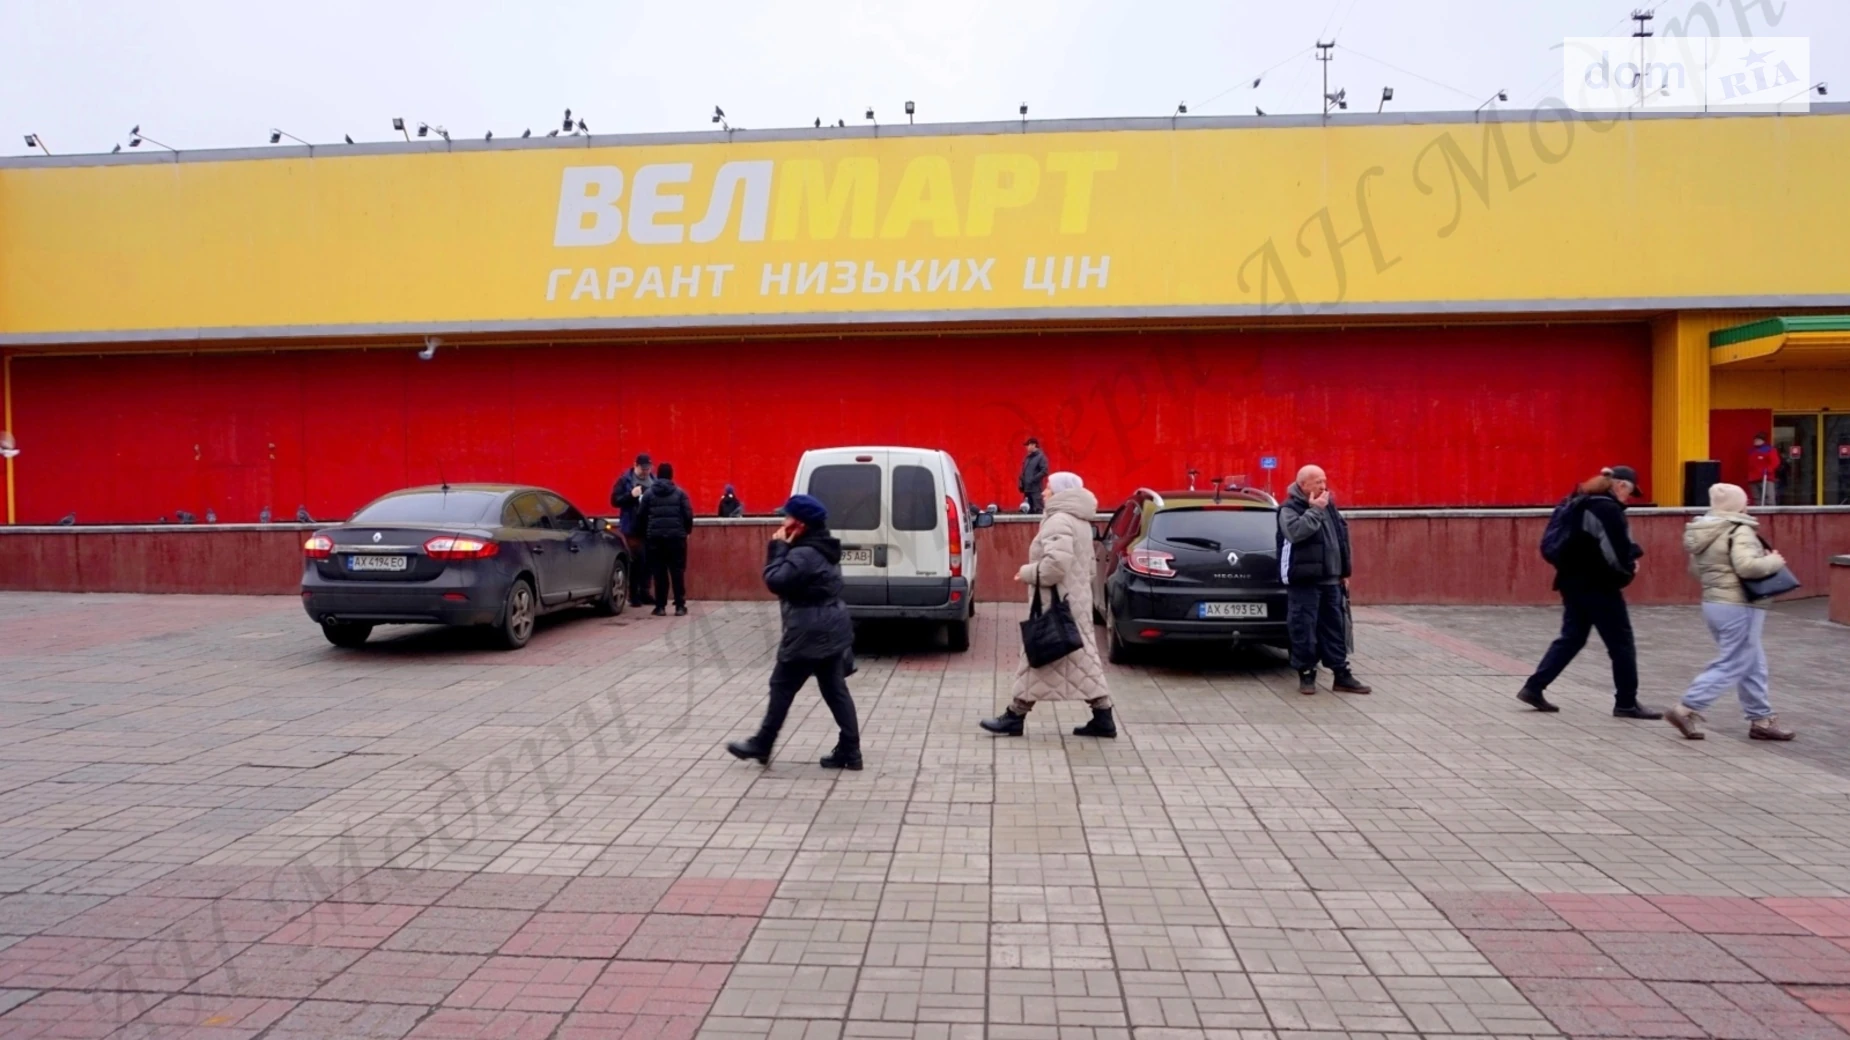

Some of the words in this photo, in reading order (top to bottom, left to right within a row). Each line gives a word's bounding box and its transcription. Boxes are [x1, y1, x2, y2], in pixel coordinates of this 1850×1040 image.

[553, 151, 1118, 247] ВЕЛМАРТ
[546, 263, 734, 301] ГАРАНТ
[759, 257, 996, 296] НИЗЬКИХ
[1022, 254, 1111, 296] ЦІН
[369, 556, 390, 568] 4194
[854, 551, 867, 561] AB
[1206, 604, 1221, 615] AX
[1223, 604, 1248, 615] 6193
[1249, 604, 1264, 615] EX
